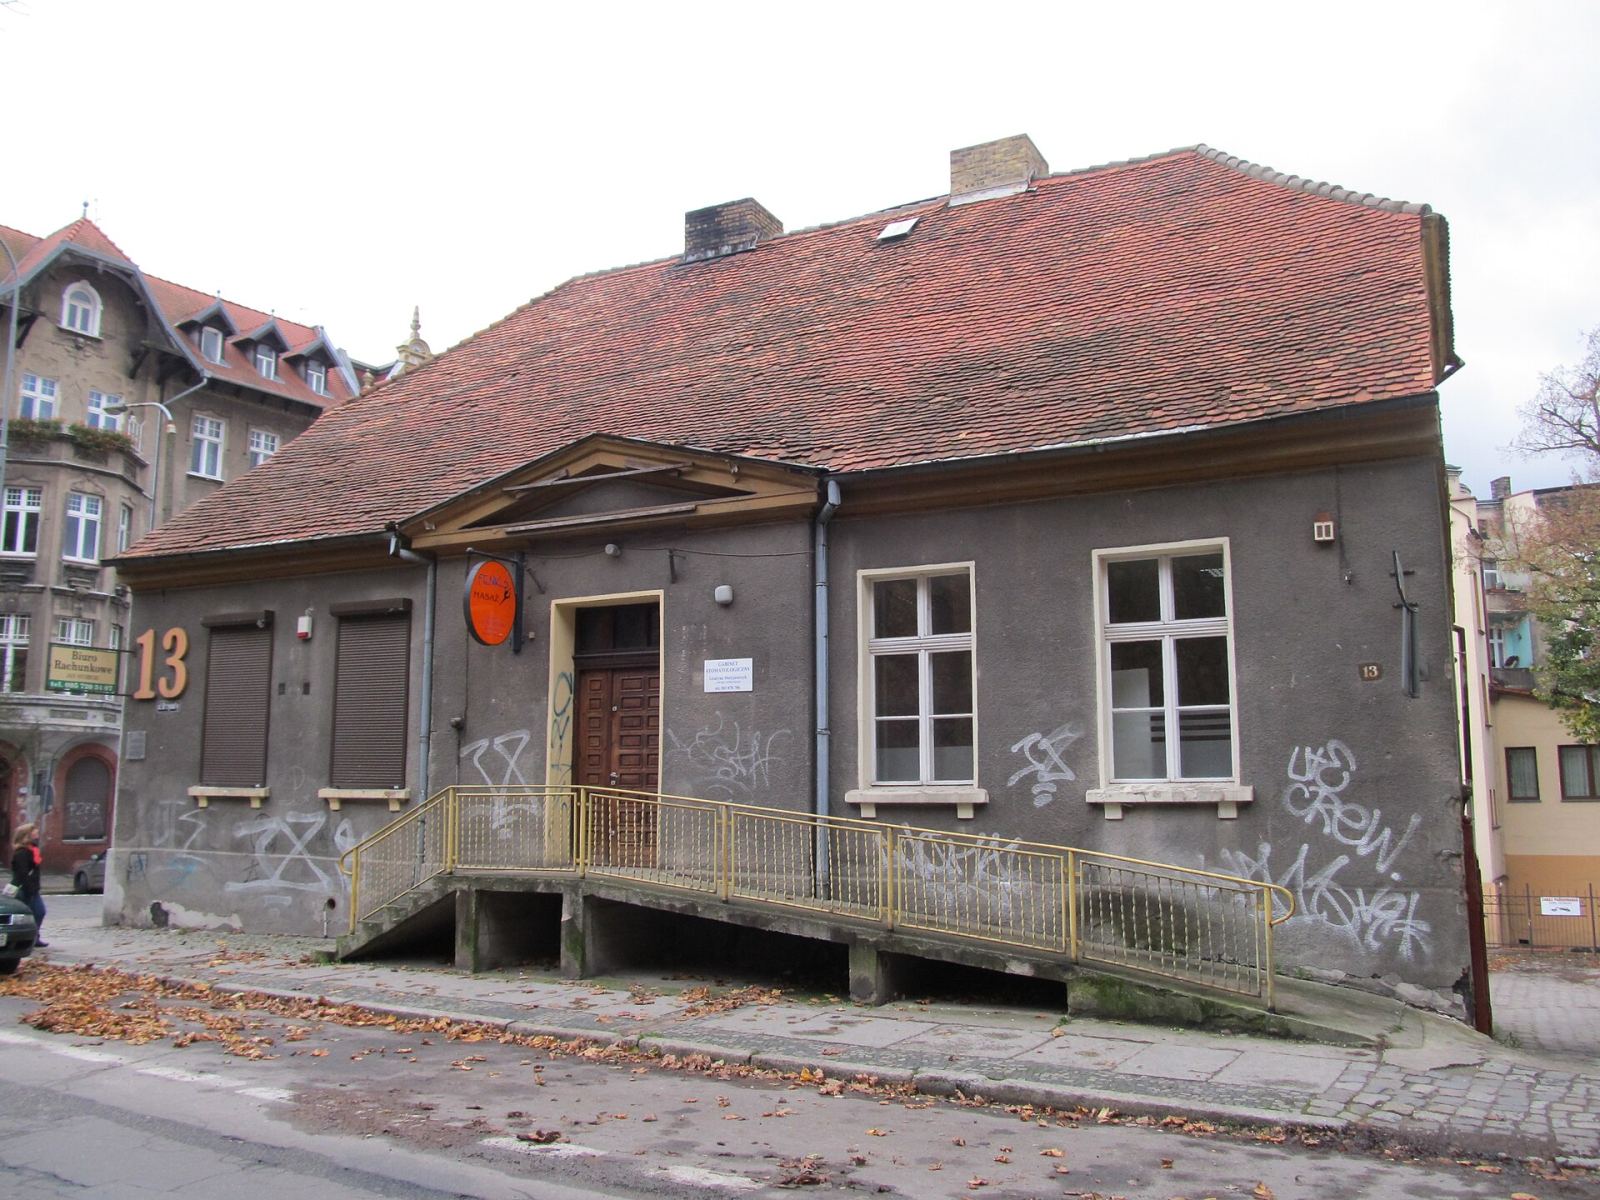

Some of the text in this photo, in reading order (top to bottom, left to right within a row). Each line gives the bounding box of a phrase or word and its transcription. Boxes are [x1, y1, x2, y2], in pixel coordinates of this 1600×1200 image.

[72, 650, 98, 662] Biuro
[133, 626, 188, 699] 13
[54, 659, 112, 674] Rachunkowe
[1362, 665, 1378, 678] 13
